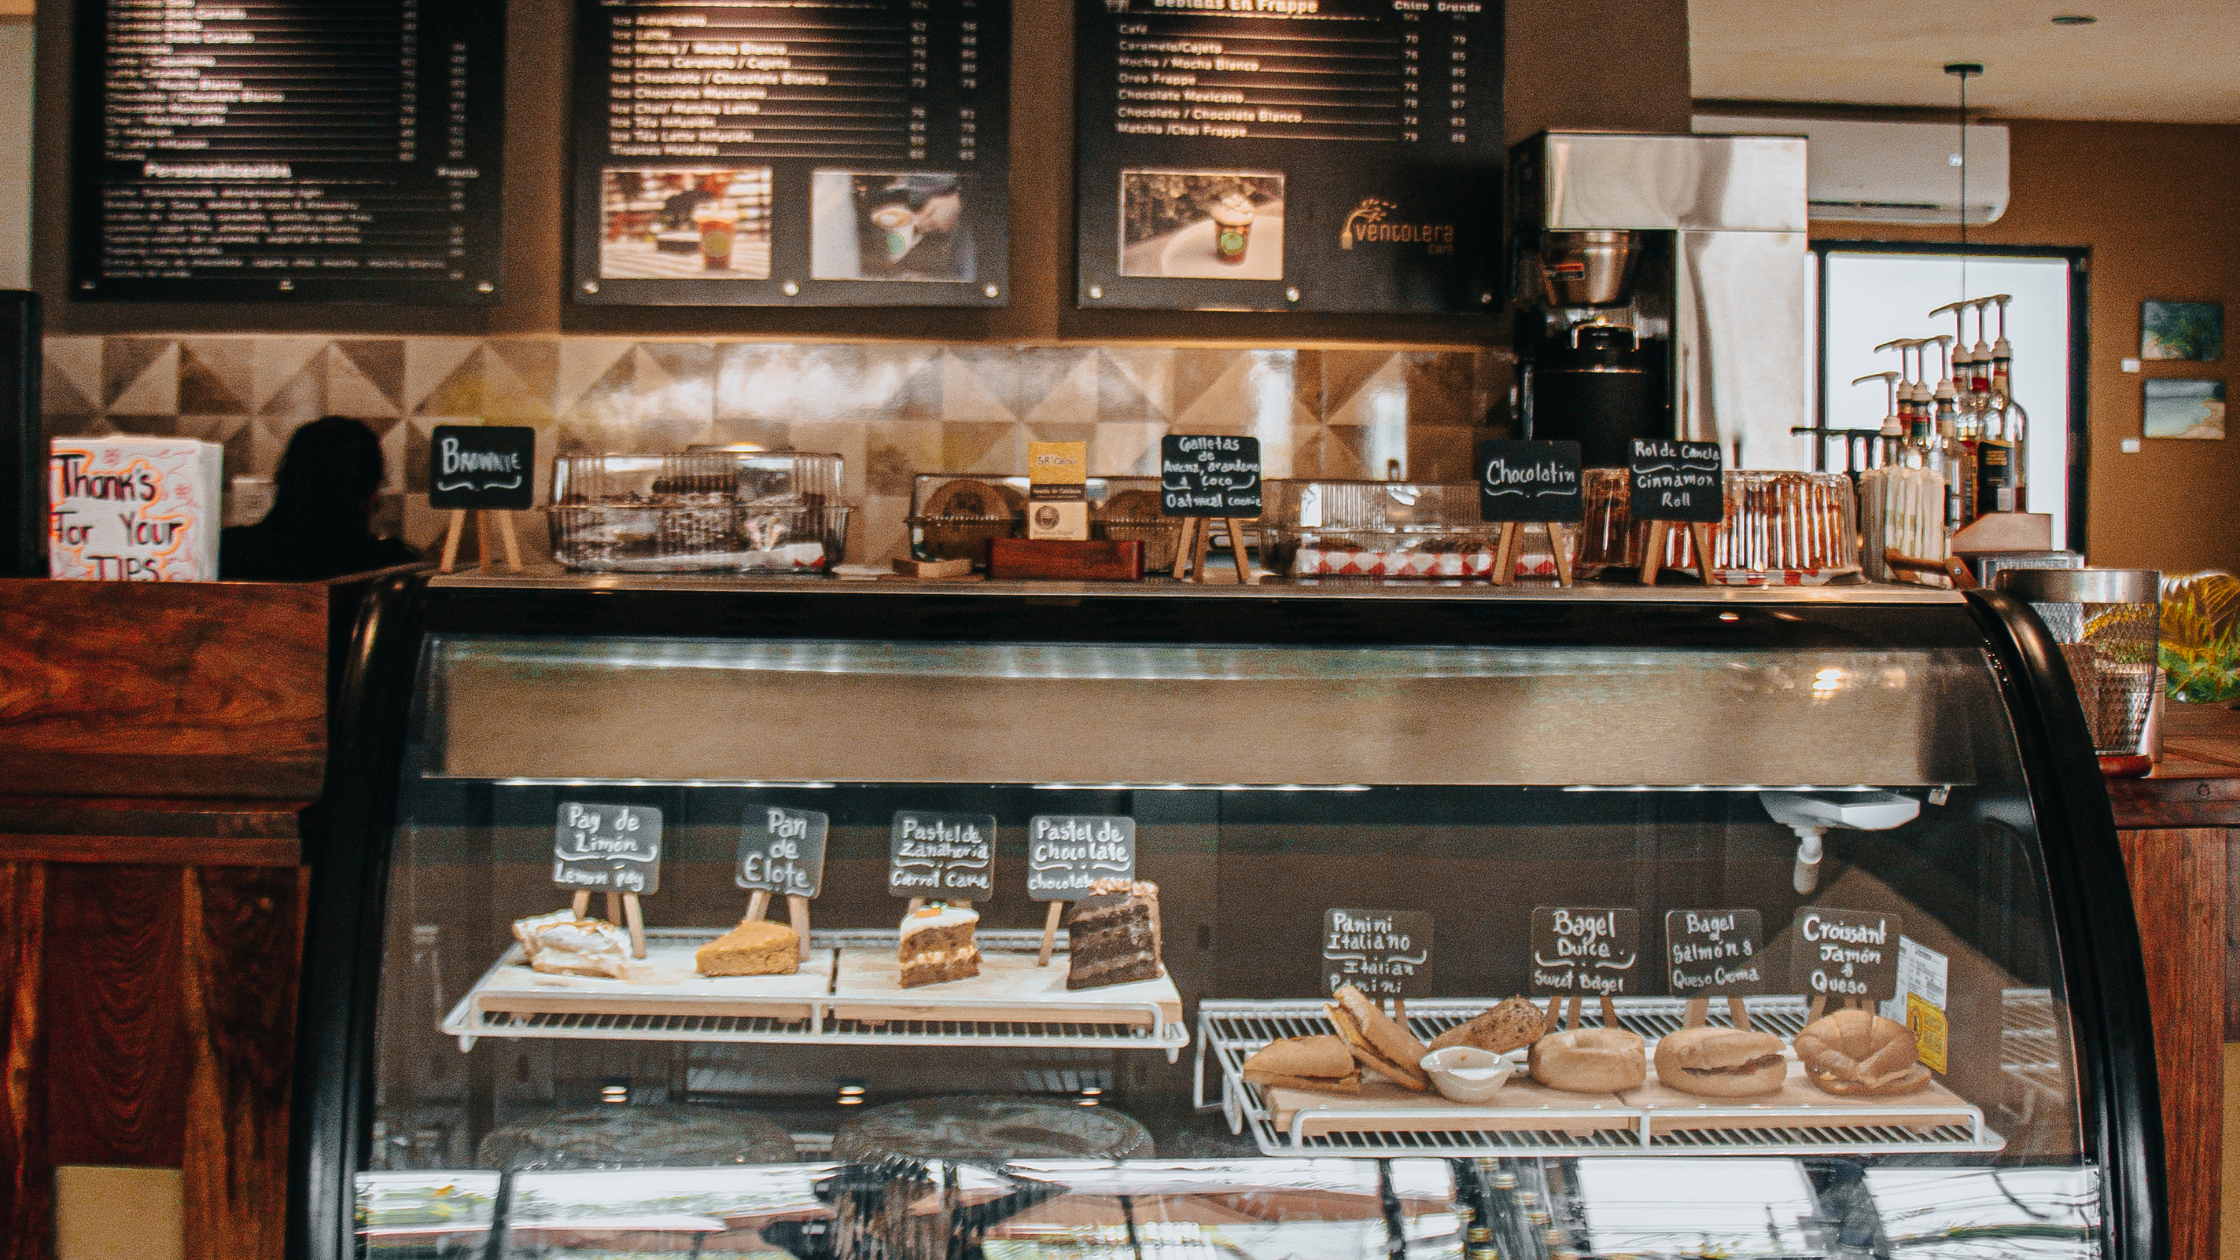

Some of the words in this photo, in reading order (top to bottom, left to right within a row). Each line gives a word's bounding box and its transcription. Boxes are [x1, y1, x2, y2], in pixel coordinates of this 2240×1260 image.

[1179, 436, 1240, 452] Galletas
[1635, 441, 1658, 457] Rol
[1660, 442, 1677, 457] de
[1198, 450, 1215, 461] de
[1637, 474, 1714, 488] Cinnamon
[1662, 491, 1690, 507] Roll
[119, 511, 183, 546] Your
[569, 804, 600, 833] Pay
[615, 807, 640, 831] de
[767, 808, 807, 839] Pan
[902, 819, 960, 843] Pastel
[1037, 820, 1092, 842] Pastel
[1097, 821, 1124, 842] de
[770, 839, 799, 859] de
[1035, 842, 1129, 862] Chocolate
[744, 852, 810, 888] Elote
[1333, 912, 1392, 934] Panini
[1553, 909, 1615, 946] Bagel
[1686, 912, 1734, 941] Bagel
[1803, 913, 1886, 945] Croissant
[1327, 933, 1410, 950] Italiano
[1557, 937, 1610, 957] Dulce
[1819, 944, 1881, 964] Jamón
[1343, 960, 1414, 975] Italian
[1672, 968, 1712, 989] Queso
[1810, 969, 1867, 994] Queso
